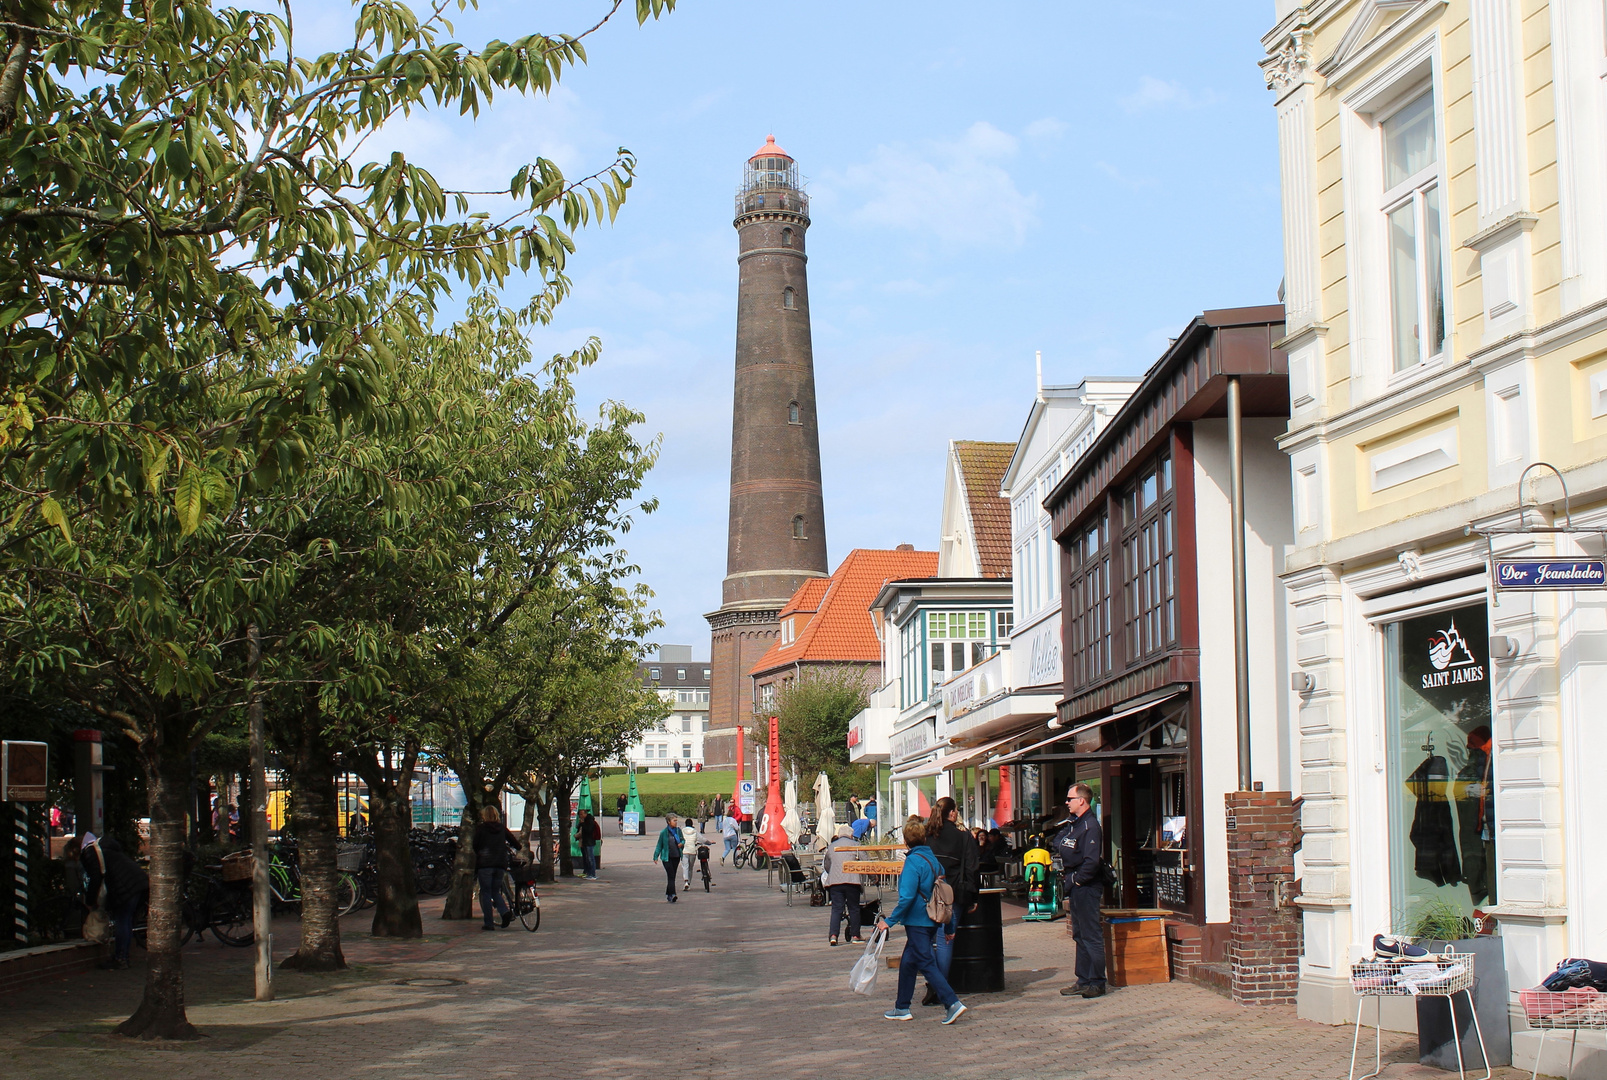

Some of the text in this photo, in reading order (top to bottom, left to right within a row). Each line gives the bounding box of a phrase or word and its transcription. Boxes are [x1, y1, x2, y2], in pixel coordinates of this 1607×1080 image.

[1501, 564, 1603, 584] Der Jeansladen
[1422, 665, 1484, 689] SAINT JAMES
